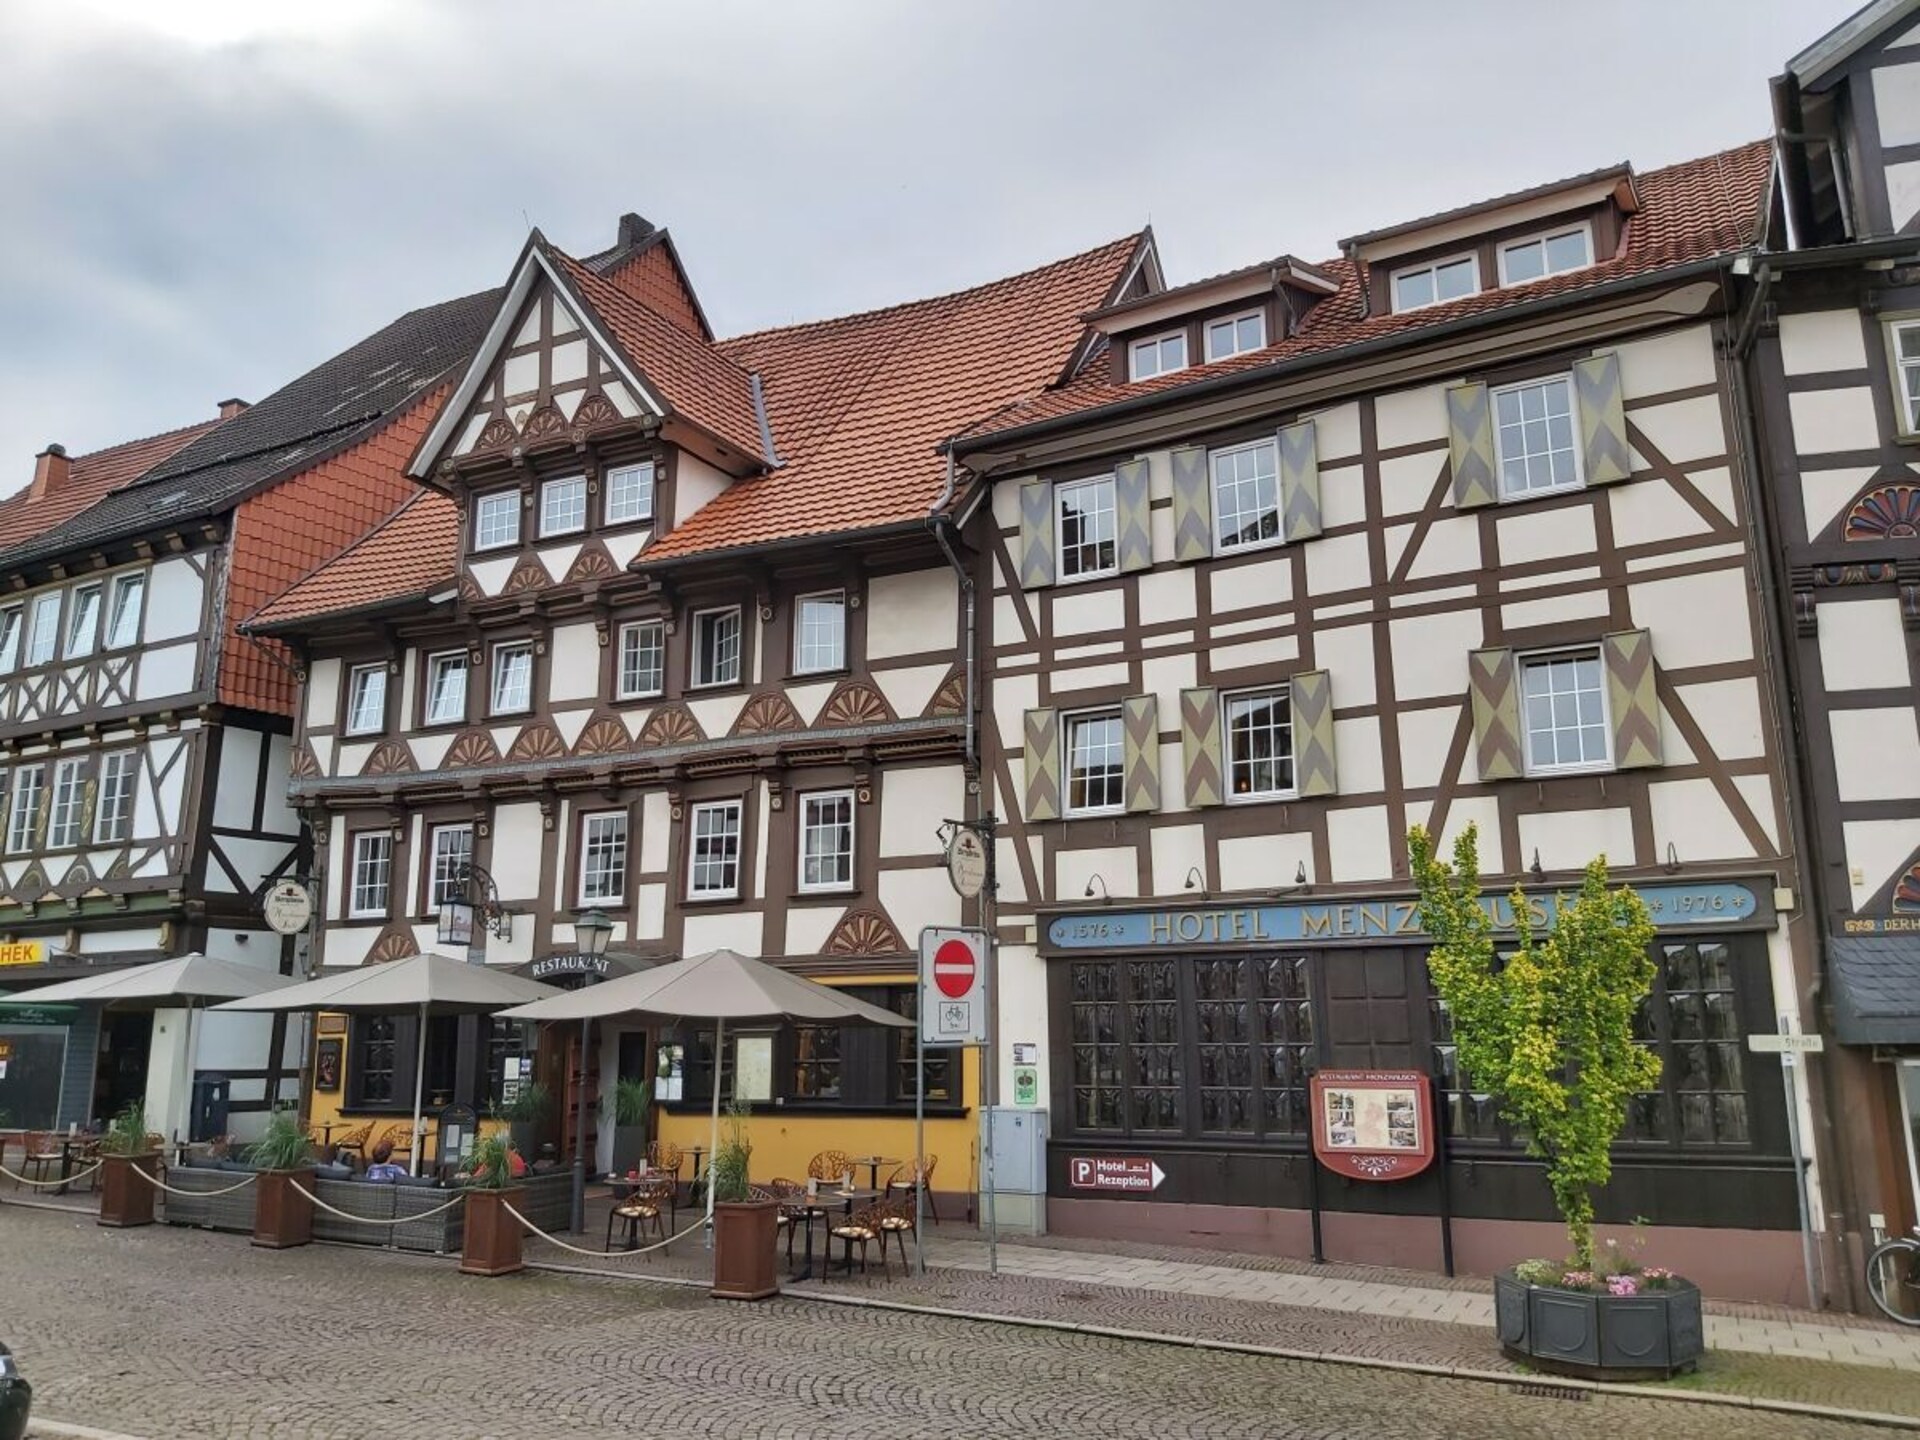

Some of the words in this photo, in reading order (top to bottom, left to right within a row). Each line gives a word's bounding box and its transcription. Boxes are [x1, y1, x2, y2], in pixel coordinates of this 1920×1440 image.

[1150, 909, 1269, 943] HOTEL
[1672, 895, 1724, 913] 1976
[1097, 1160, 1126, 1172] Hotel
[1097, 1174, 1150, 1189] Rezeption
